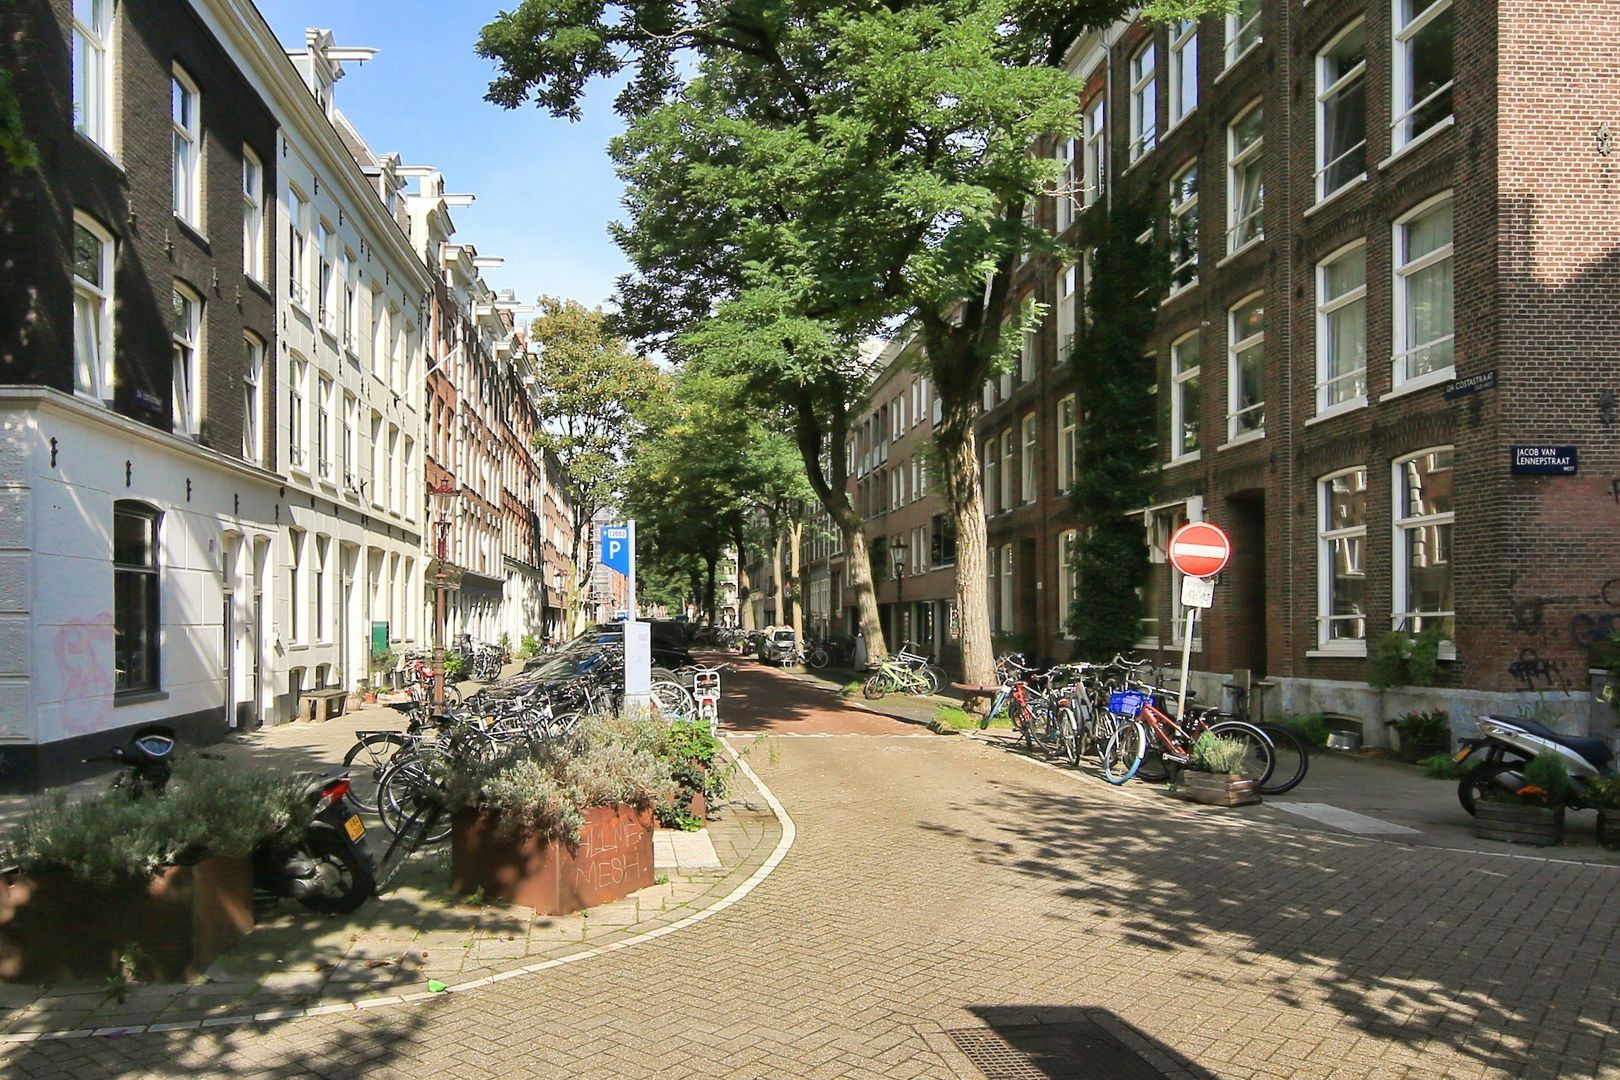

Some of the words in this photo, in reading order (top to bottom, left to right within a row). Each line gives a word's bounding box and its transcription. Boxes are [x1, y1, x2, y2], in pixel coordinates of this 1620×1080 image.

[1455, 372, 1493, 390] COSTASTRAAT
[1516, 448, 1539, 457] JACOB
[1541, 448, 1556, 456] VAN
[1516, 456, 1570, 465] LENNEPSTRAAT
[609, 541, 621, 559] P
[574, 851, 641, 895] MESH
